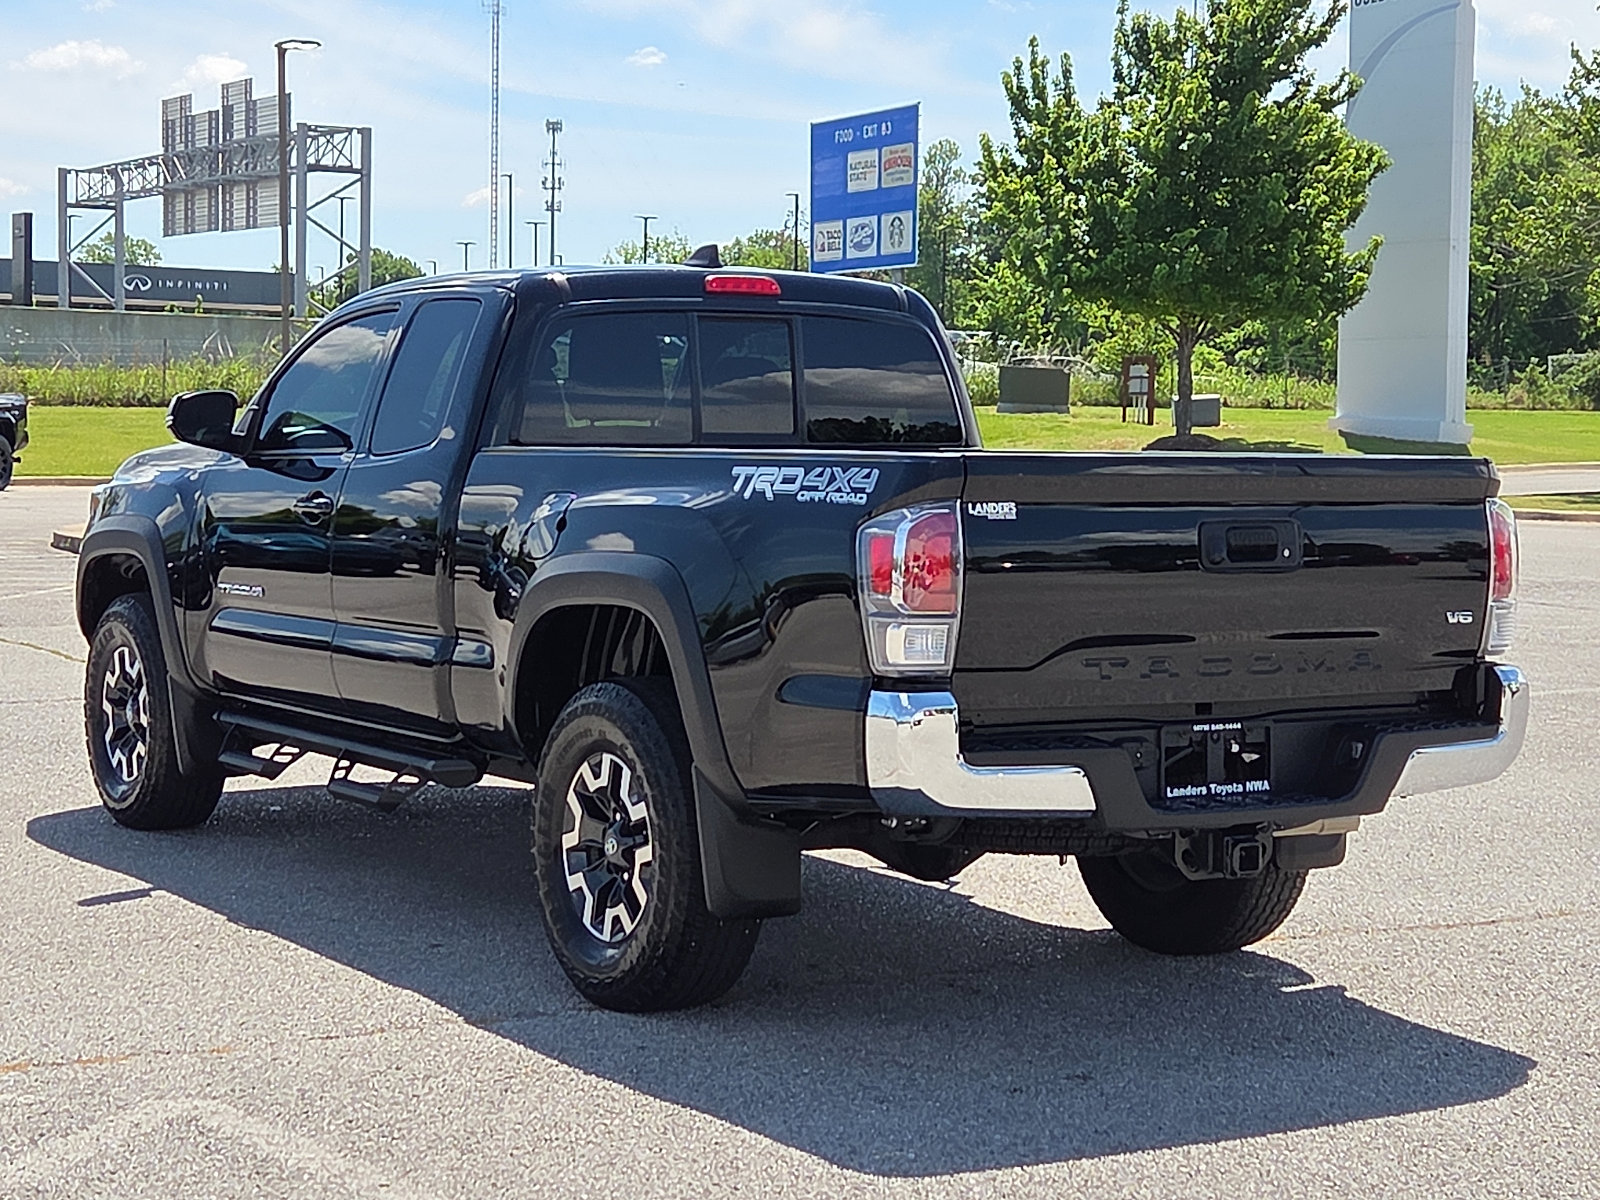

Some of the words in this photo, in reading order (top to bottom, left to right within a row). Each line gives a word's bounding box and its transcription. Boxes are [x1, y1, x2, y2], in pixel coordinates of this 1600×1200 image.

[835, 128, 853, 143] FOOD
[863, 123, 877, 138] EXIT
[849, 159, 877, 171] NATURAL
[849, 171, 867, 182] STATE
[826, 229, 842, 240] TACO
[827, 240, 842, 252] BELL
[158, 280, 227, 291] INFINITI
[732, 466, 804, 500] TRD
[796, 491, 826, 503] OFF
[826, 492, 868, 505] ROAD
[968, 502, 1017, 515] LANDERS
[1446, 611, 1473, 624] V6
[1081, 649, 1382, 680] TACOMA
[1166, 785, 1208, 798] Landers
[1209, 782, 1244, 796] Toyota
[1245, 780, 1270, 792] NWA
